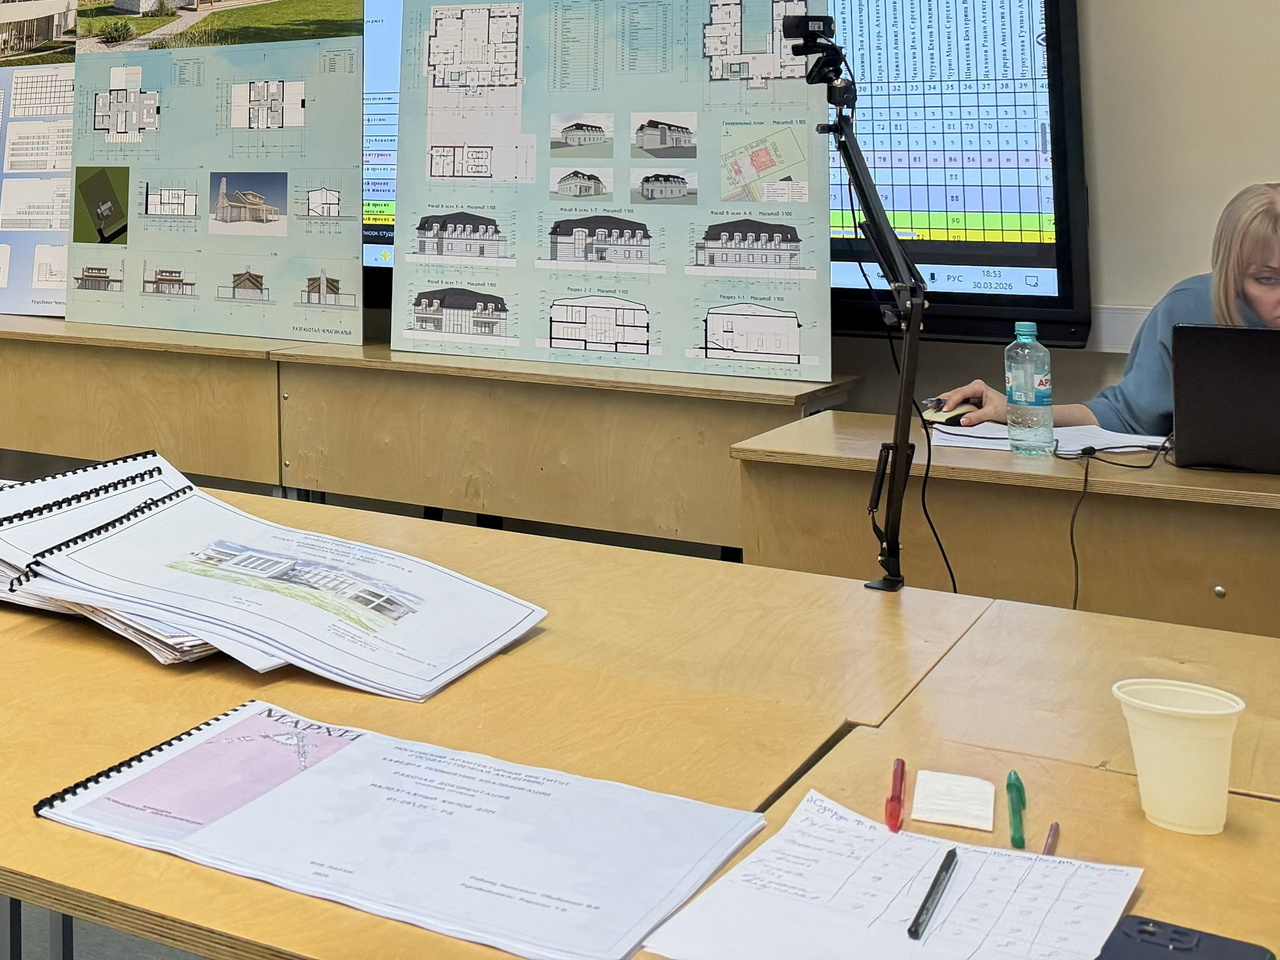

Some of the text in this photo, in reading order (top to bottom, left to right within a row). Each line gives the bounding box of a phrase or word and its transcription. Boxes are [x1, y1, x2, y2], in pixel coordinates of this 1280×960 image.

[947, 275, 963, 283] РУС
[972, 281, 1013, 290] 30.03.2026
[981, 270, 1002, 278] 18:53
[258, 707, 368, 742] МАРХИ
[381, 757, 422, 769] КАФЕДРА
[478, 779, 552, 797] КВАЛИФИКАЦИИ
[393, 745, 571, 787] МОСКОВСКИЙ АРХИТЕКТУРНЫЙ ИНСТИТУТ
[369, 783, 496, 815] МАЛОЭТАЖНЫЙ ЖИЛОЙ ДОМ
[392, 771, 511, 801] РАБОЧАЯ ДОКУМЕНТАЦИЯ
